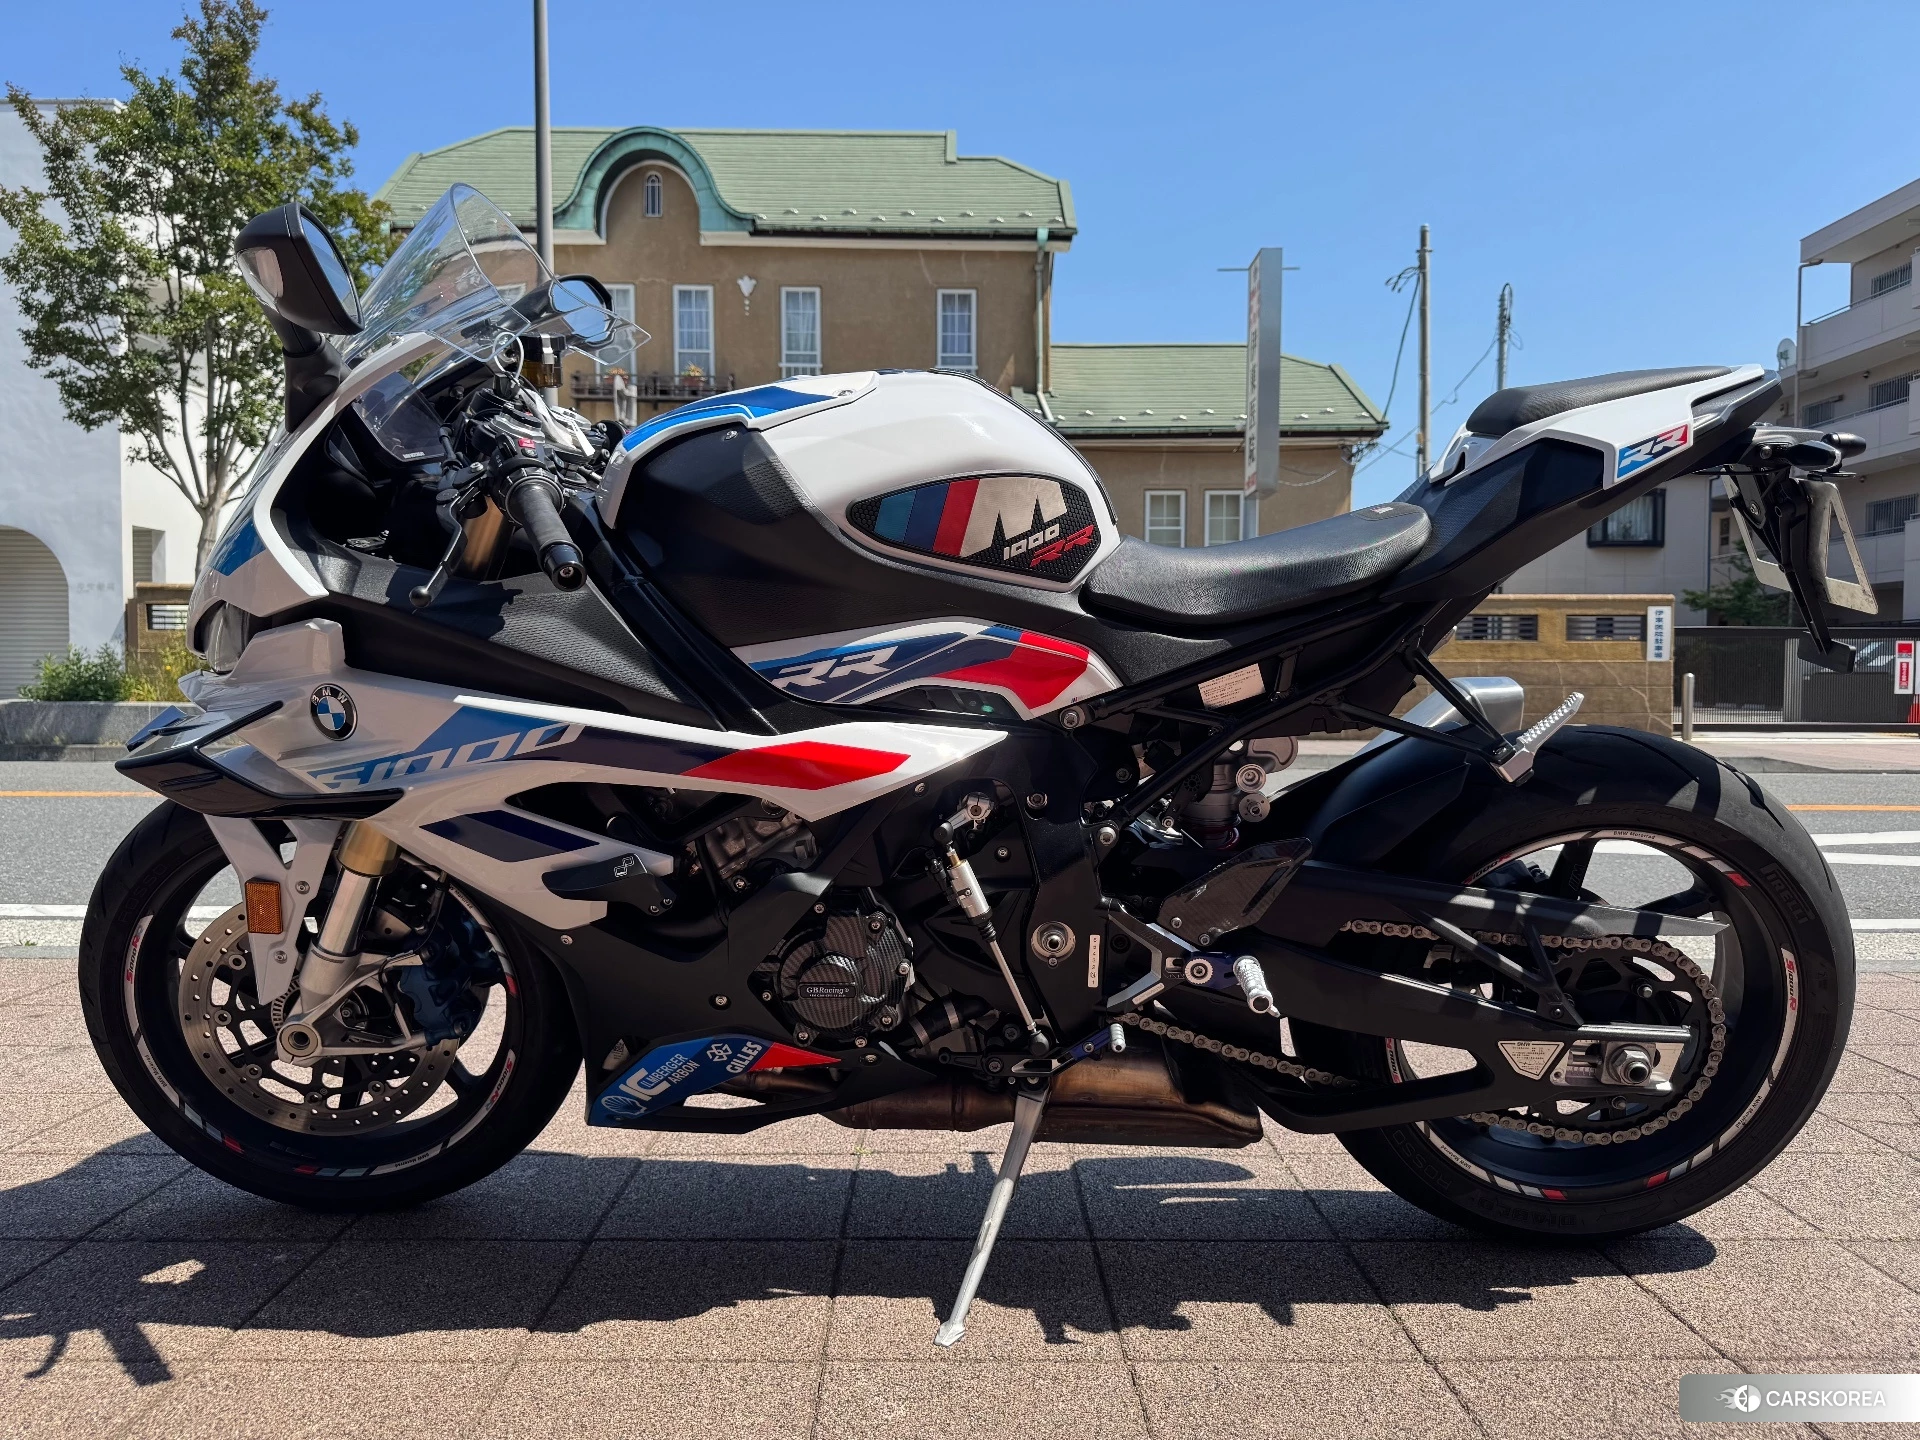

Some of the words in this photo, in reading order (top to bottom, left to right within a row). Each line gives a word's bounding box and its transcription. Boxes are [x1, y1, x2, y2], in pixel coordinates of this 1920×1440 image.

[1003, 523, 1060, 561] 1000
[1029, 524, 1095, 568] RR
[770, 645, 899, 690] RR
[311, 686, 349, 706] BMW
[1759, 861, 1816, 924] PIRELLI
[640, 1053, 689, 1089] ILMBERGER
[725, 1041, 763, 1074] GILLES
[1391, 1129, 1454, 1191] ROSSO
